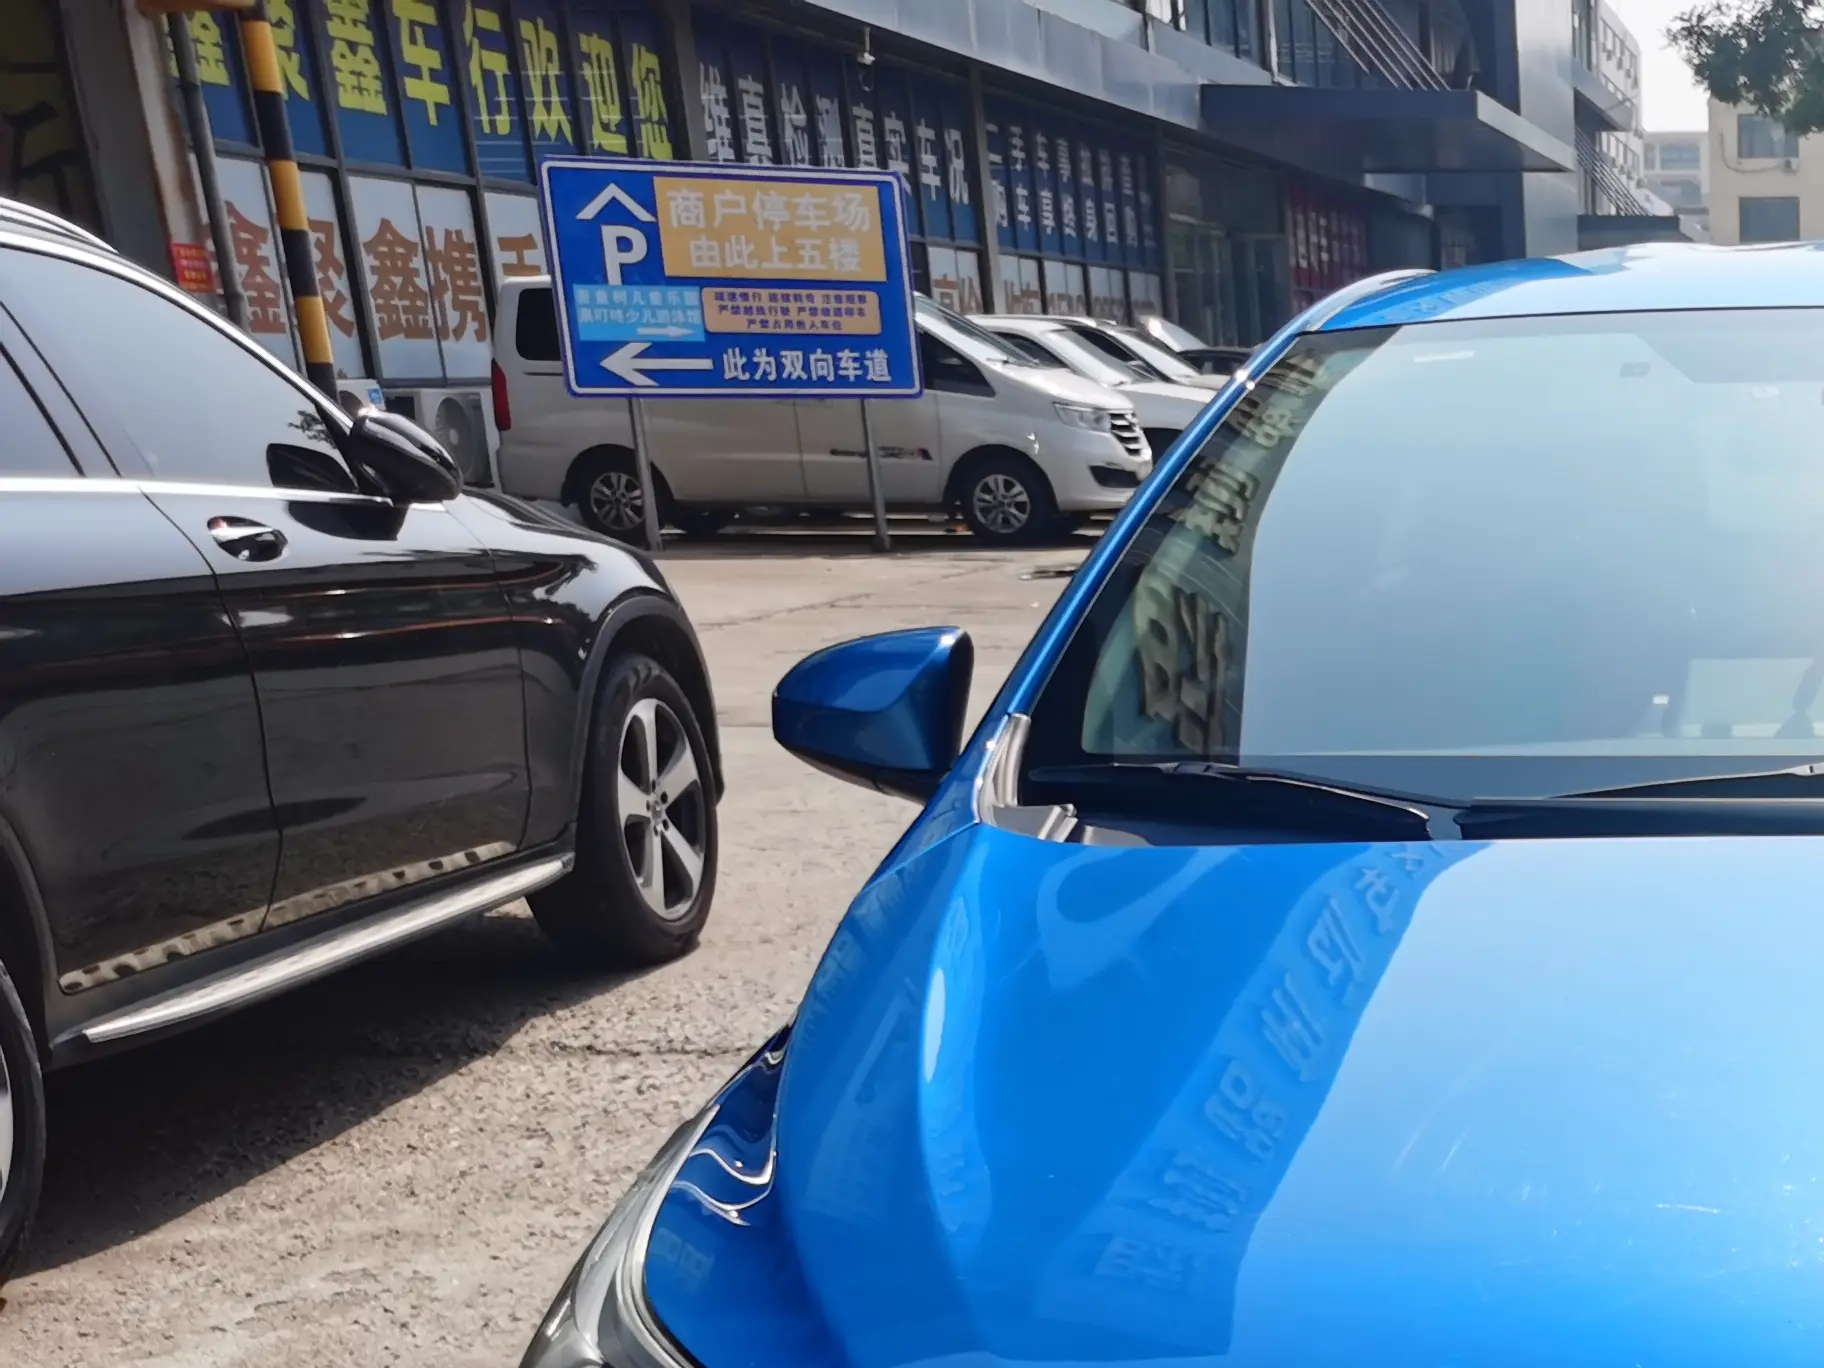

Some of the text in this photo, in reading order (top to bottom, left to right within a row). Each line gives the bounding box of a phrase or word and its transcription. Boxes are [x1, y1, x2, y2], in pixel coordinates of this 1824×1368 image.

[667, 188, 871, 232] 商户停车场
[601, 225, 648, 285] P
[689, 235, 862, 273] 由此上五楼
[723, 347, 892, 382] 此为双向车道
